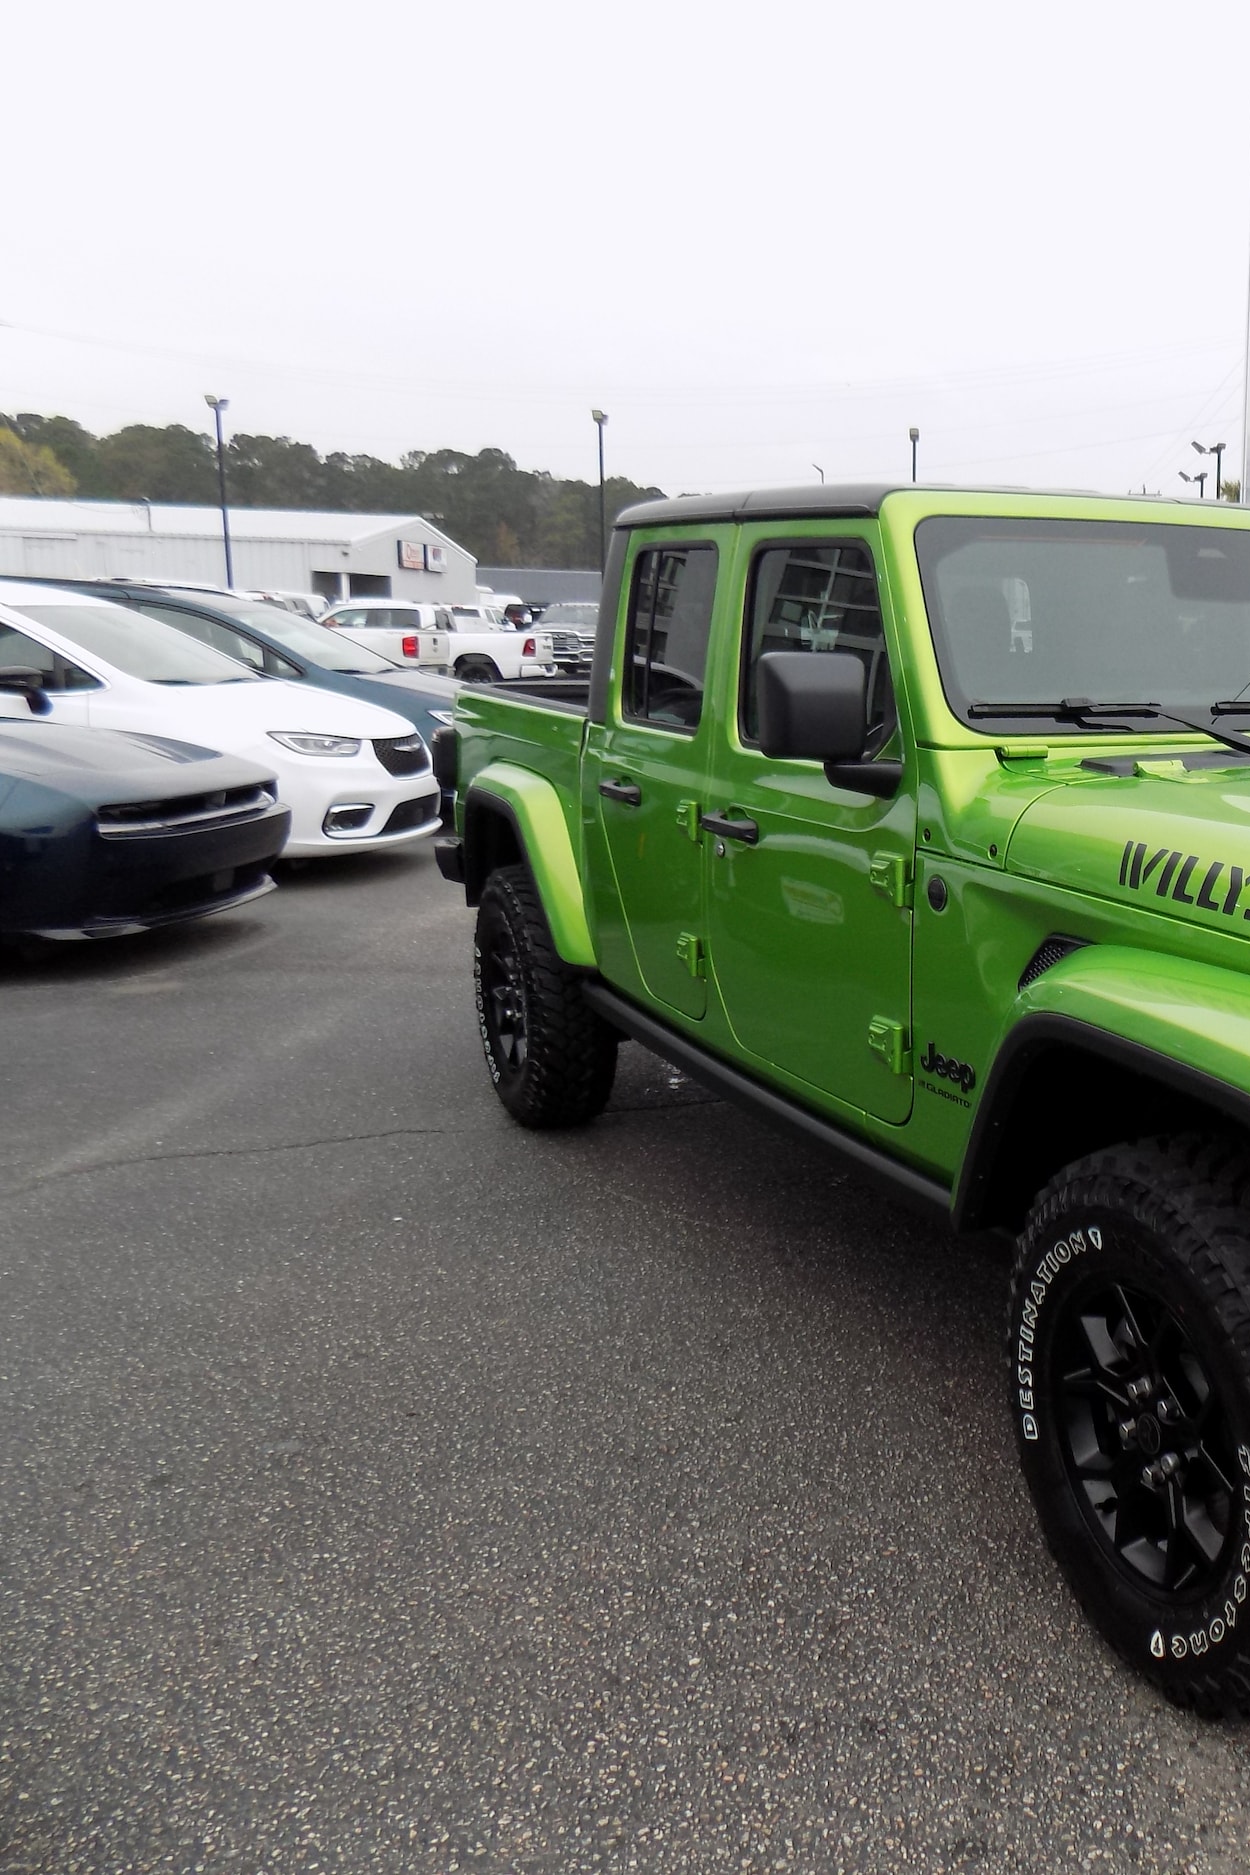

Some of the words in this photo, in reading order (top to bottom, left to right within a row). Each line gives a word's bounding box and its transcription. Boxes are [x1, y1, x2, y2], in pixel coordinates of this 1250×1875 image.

[920, 1041, 976, 1094] Jeep
[926, 1082, 972, 1110] GLADIATO
[1018, 1229, 1087, 1440] DESTINATION
